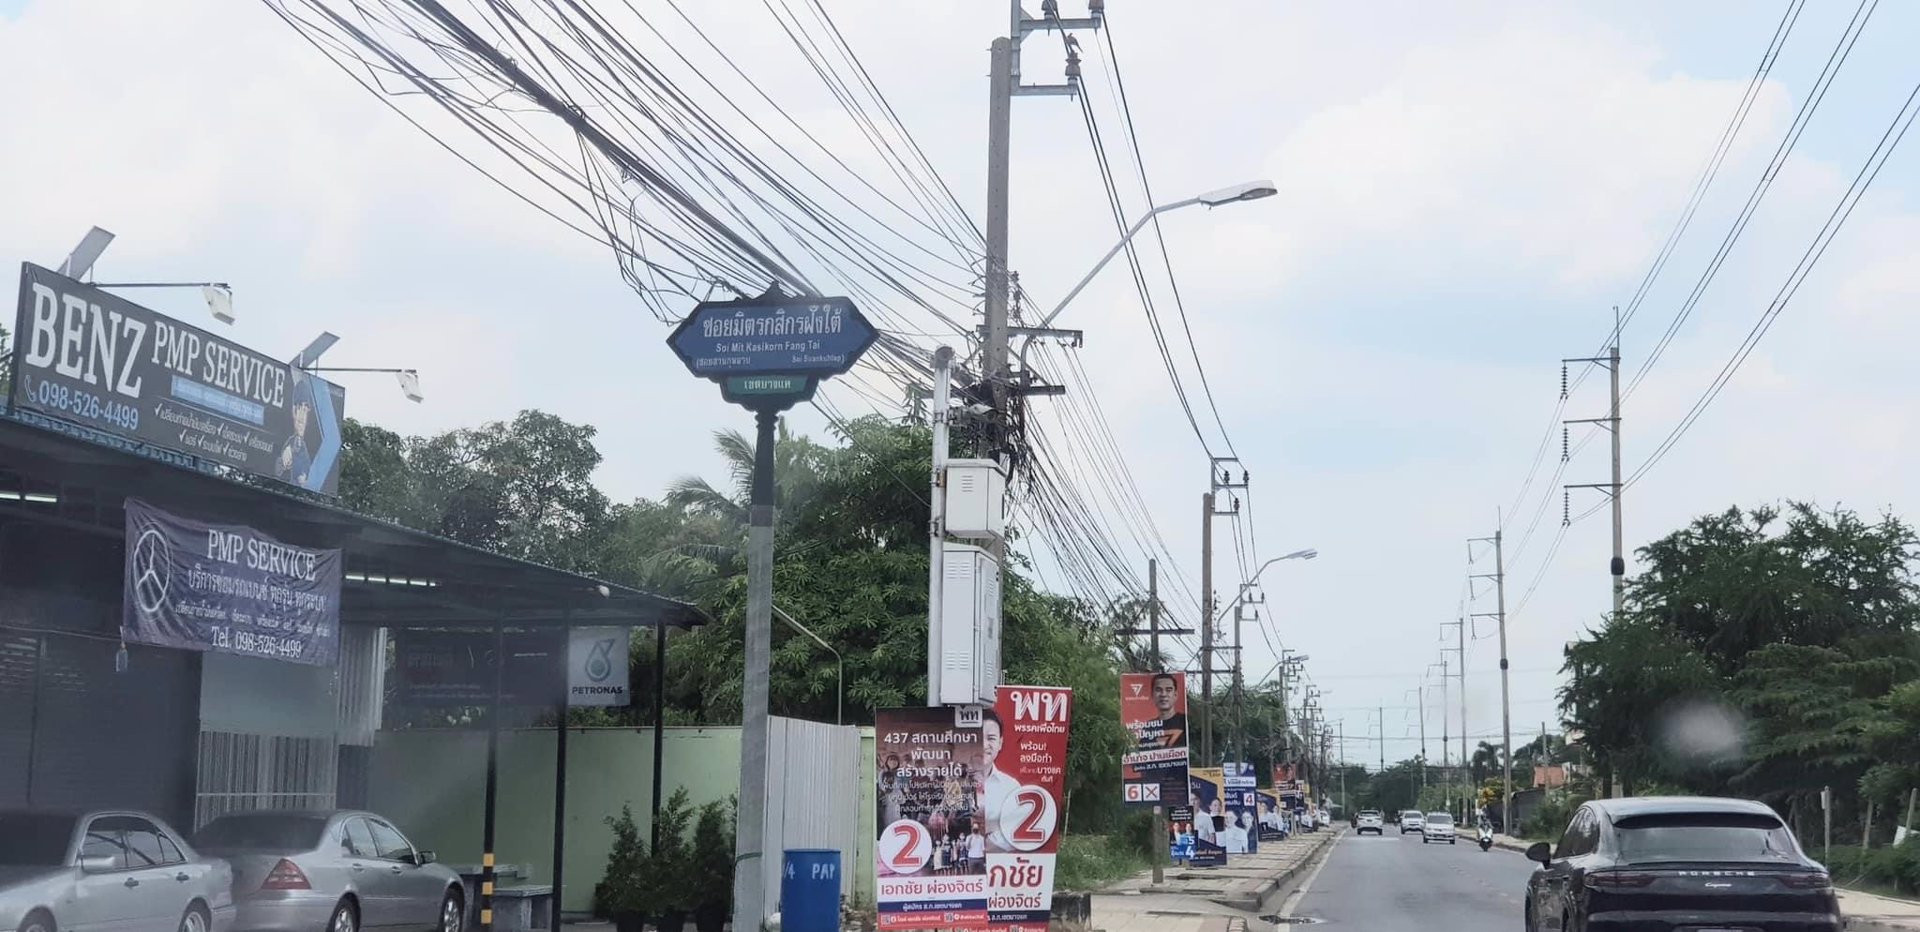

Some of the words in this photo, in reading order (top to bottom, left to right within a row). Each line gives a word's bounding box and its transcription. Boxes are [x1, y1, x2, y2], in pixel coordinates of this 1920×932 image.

[703, 304, 841, 338] ซอยมิตรกสิกรฝั่งใต้
[26, 282, 148, 399] BENZ
[716, 343, 730, 353] Soi
[731, 342, 745, 352] Mit
[746, 342, 783, 352] Kasikorn
[785, 341, 805, 353] Fang
[808, 340, 820, 350] Tai
[151, 320, 201, 376] PMP
[202, 341, 286, 409] SERVICE
[39, 380, 139, 431] 098-526-4499
[207, 528, 244, 565] PMP
[247, 537, 317, 581] SERVICE
[211, 625, 232, 648] Tel.
[235, 630, 302, 659] 098-526-4499
[571, 685, 623, 696] PETRONAS
[1010, 690, 1068, 722] พท
[959, 709, 979, 721] พท
[1014, 722, 1065, 734] พรรคเพื่อไทย
[1135, 729, 1165, 740] ปัญหา
[884, 732, 909, 744] 437
[911, 730, 978, 744] สถานศึกษา
[911, 747, 951, 761] พัฒนา
[1020, 752, 1052, 764] ลงมือทำ
[896, 761, 963, 777] สร้างรายได้
[1127, 785, 1139, 800] 6
[1012, 791, 1046, 844] 2
[891, 824, 922, 868] 2
[1188, 835, 1196, 845] 5
[1185, 846, 1196, 860] 4
[988, 857, 1043, 889] กชัย
[880, 879, 923, 896] เอกชัย
[926, 878, 984, 895] ผ่องจิตร์
[988, 891, 1043, 909] ผ่องจิตร์
